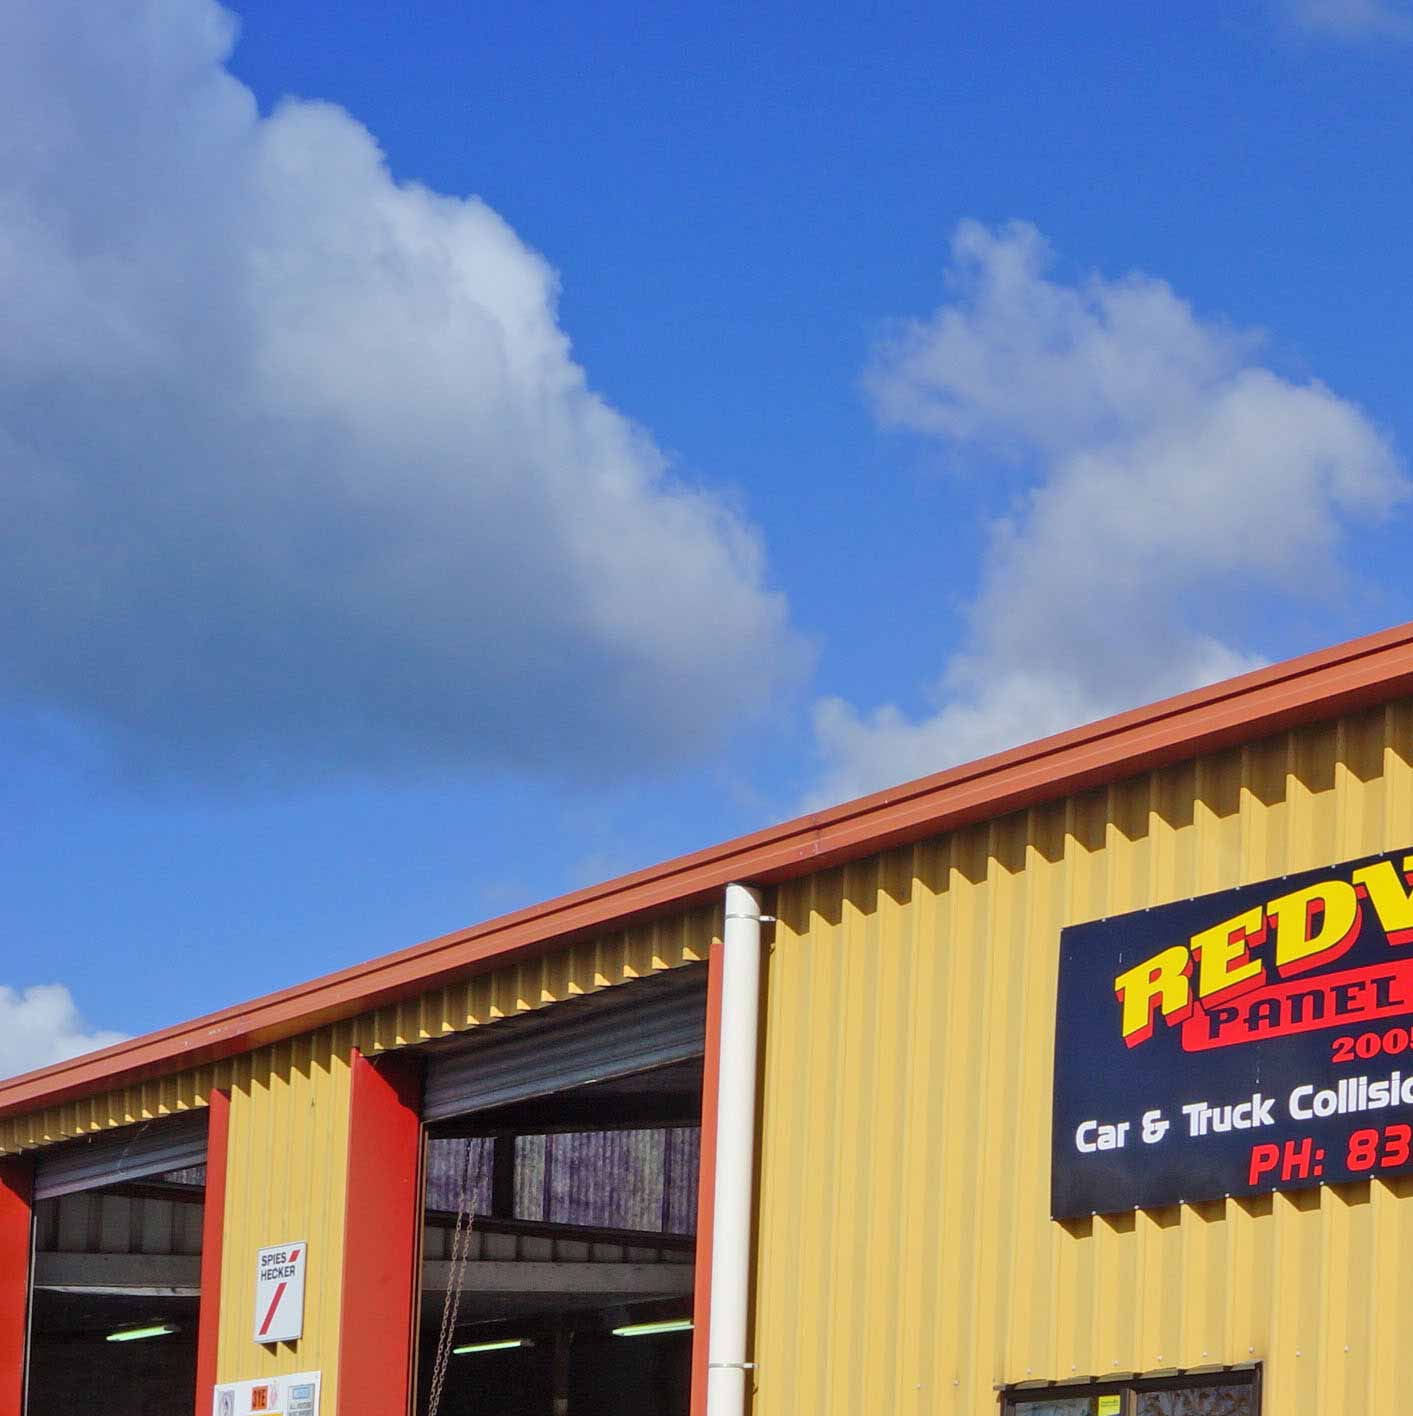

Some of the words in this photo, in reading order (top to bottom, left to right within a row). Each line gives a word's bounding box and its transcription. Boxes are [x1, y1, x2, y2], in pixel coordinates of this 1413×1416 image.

[1205, 974, 1405, 1040] PANEL
[1075, 1120, 1131, 1154] Car
[1141, 1109, 1170, 1145] &
[1182, 1093, 1276, 1138] Truck
[1248, 1137, 1325, 1187] PH:
[260, 1265, 296, 1282] HECKER
[261, 1252, 287, 1267] SPIES
